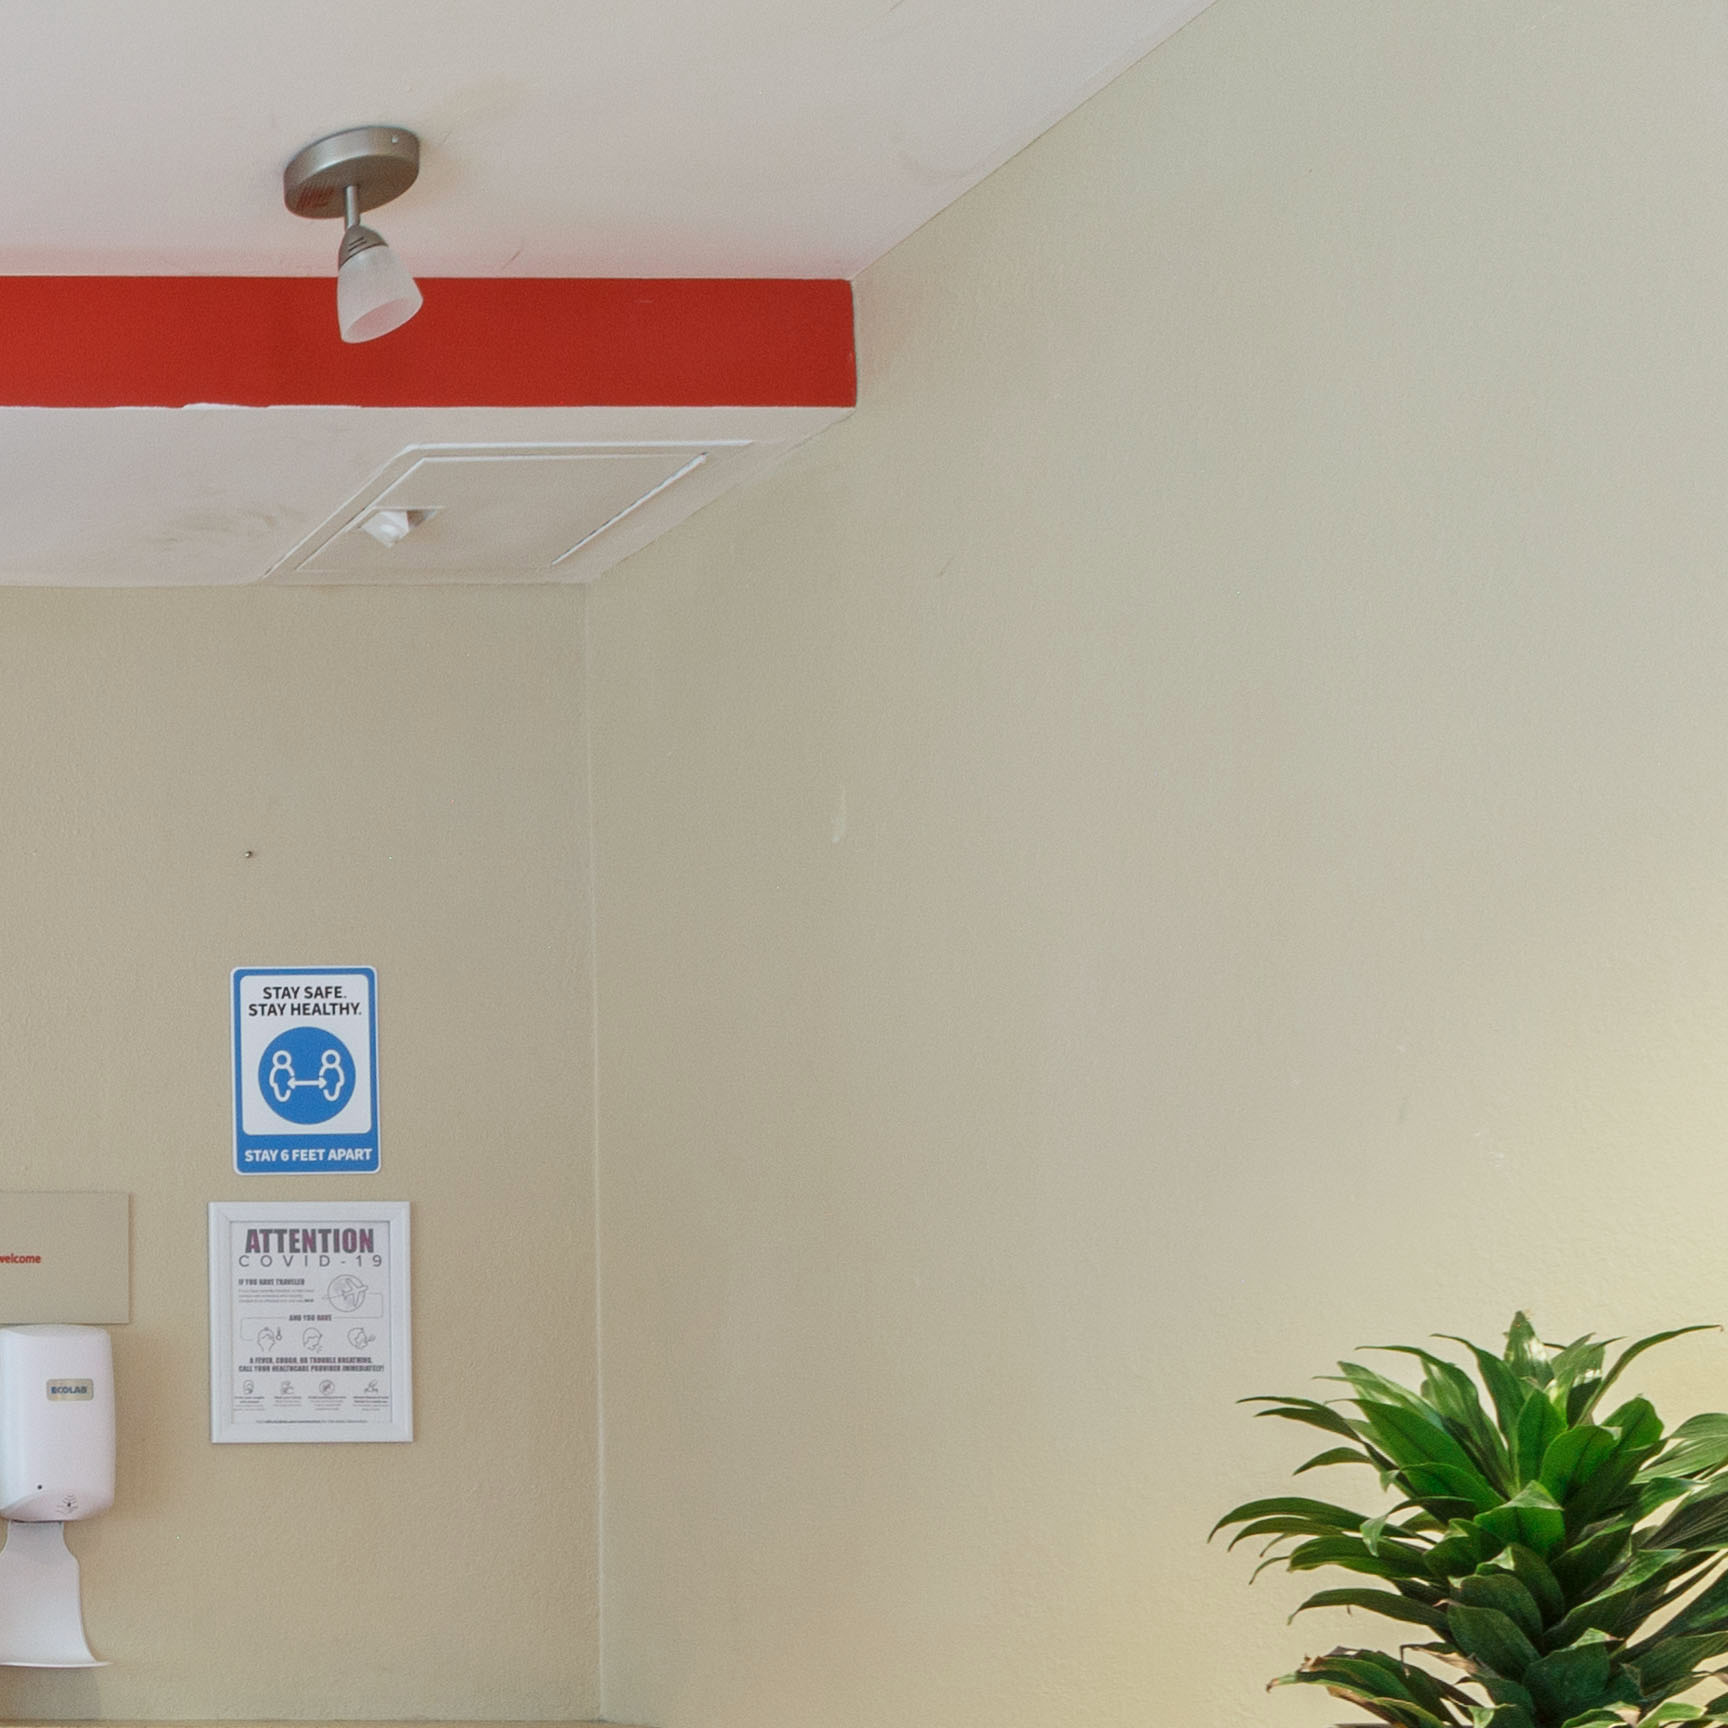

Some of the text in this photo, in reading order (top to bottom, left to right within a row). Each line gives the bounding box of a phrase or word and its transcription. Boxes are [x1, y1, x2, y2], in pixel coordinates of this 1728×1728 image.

[263, 986, 347, 999] STAY SAFE.
[248, 1002, 362, 1017] STAY HEALTHY.
[244, 1148, 373, 1162] STAY 6 FEET APART
[245, 1227, 374, 1254] ATTENTION
[238, 1255, 383, 1268] COVID-19
[50, 1385, 88, 1395] ECOLAB
